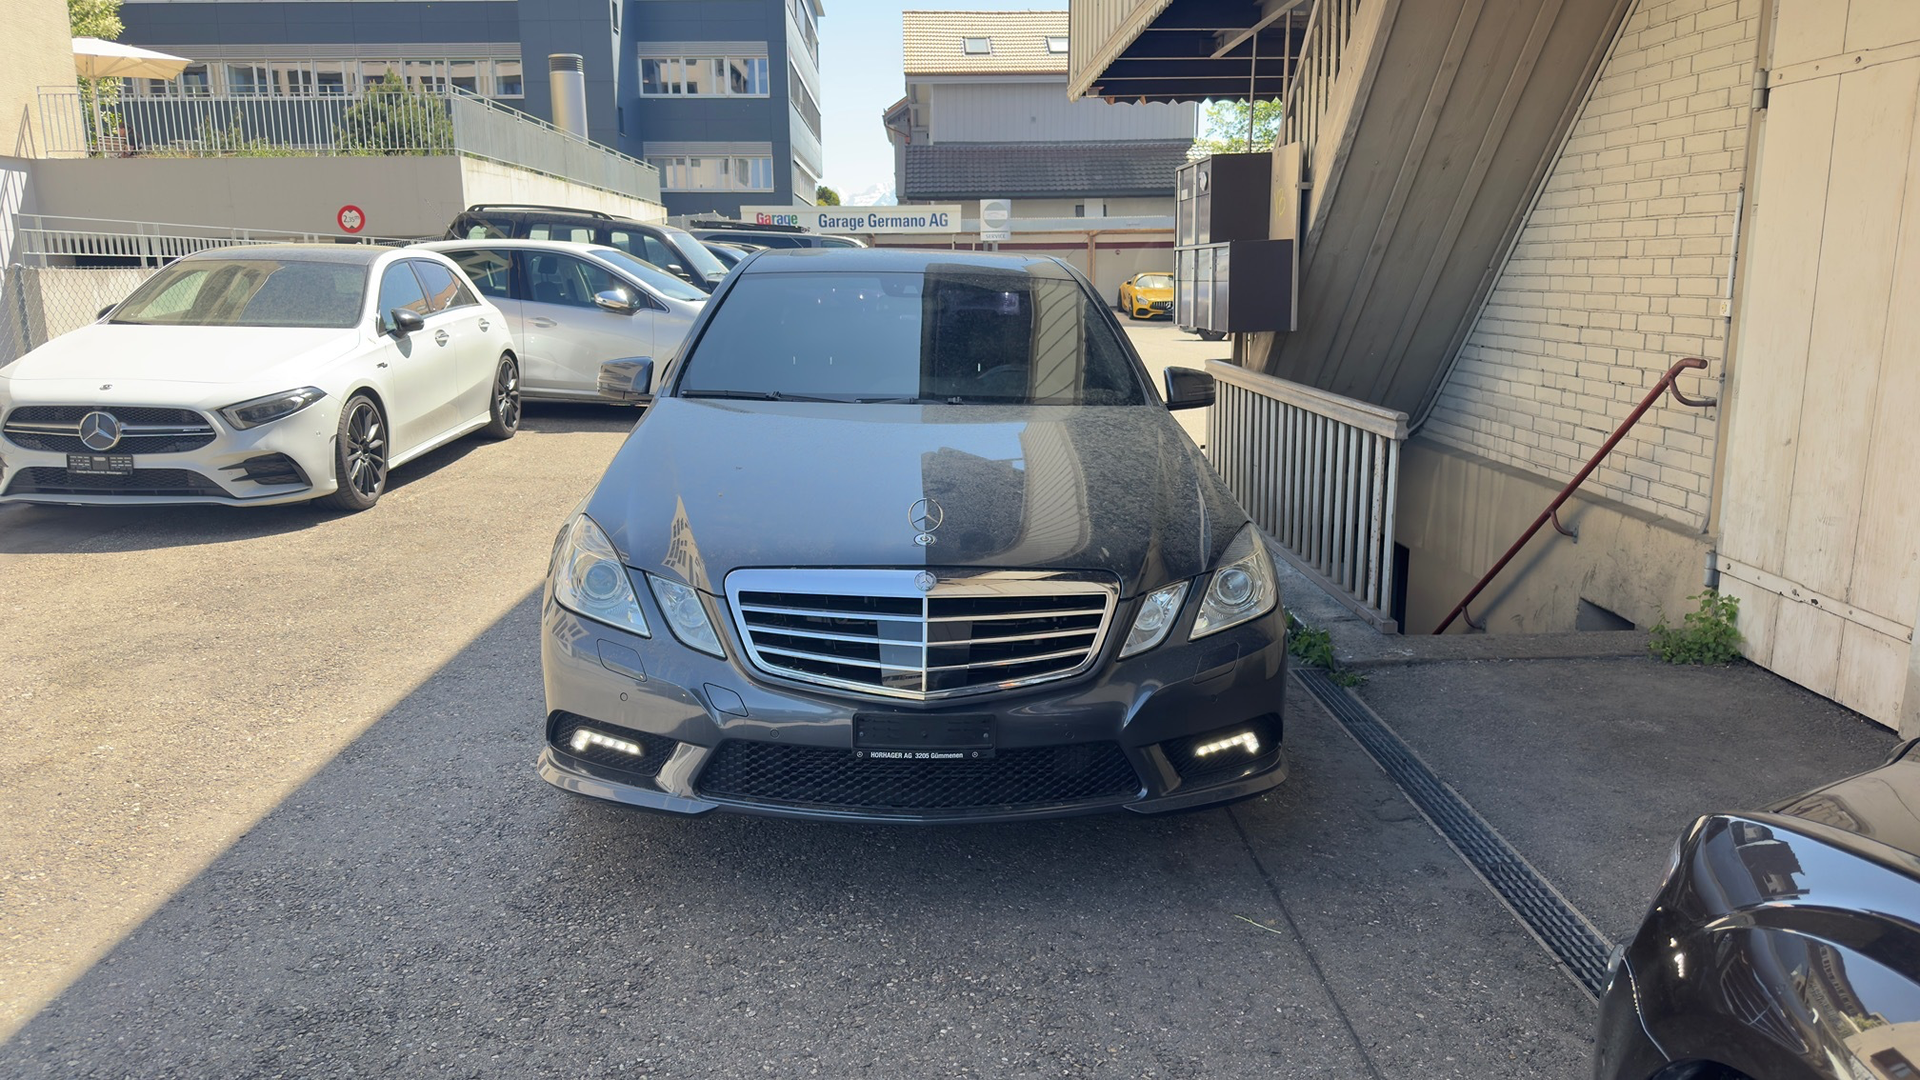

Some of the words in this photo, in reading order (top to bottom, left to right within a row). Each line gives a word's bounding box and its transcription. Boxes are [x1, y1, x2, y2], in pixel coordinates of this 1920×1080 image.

[756, 212, 798, 226] Garage
[818, 213, 864, 231] Garage
[868, 213, 926, 228] Germano
[929, 213, 949, 227] AG
[870, 751, 903, 759] HORHAGER
[930, 751, 964, 759] Gümmenen
